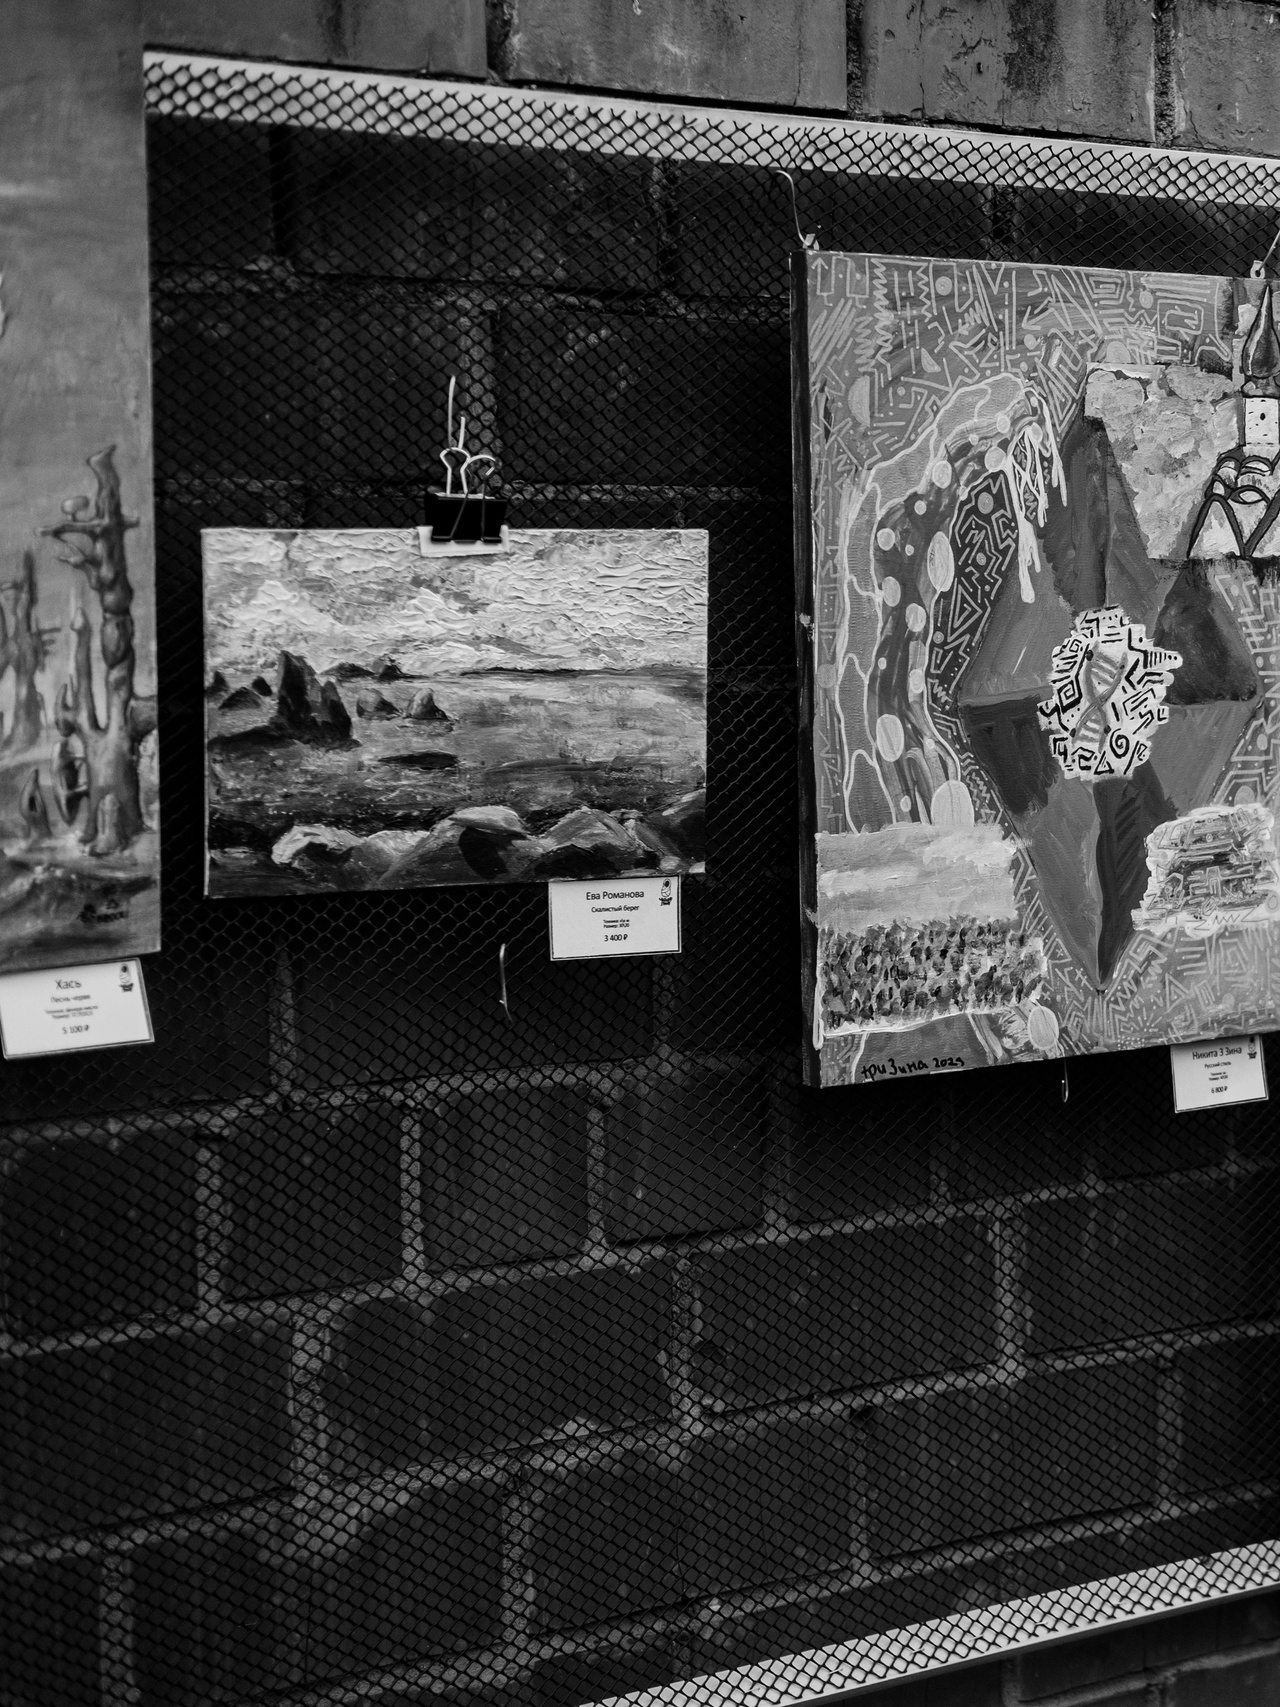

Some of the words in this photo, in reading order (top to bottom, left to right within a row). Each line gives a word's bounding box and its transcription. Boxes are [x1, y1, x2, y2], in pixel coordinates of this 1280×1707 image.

[586, 892, 600, 900] Ева
[602, 890, 645, 900] Романова
[591, 905, 622, 913] Скалистый
[623, 904, 639, 912] берег
[55, 979, 82, 989] Хась
[62, 1027, 67, 1035] 5
[69, 1025, 82, 1034] 100
[1192, 1050, 1218, 1060] Никита
[1225, 1046, 1243, 1056] Зина
